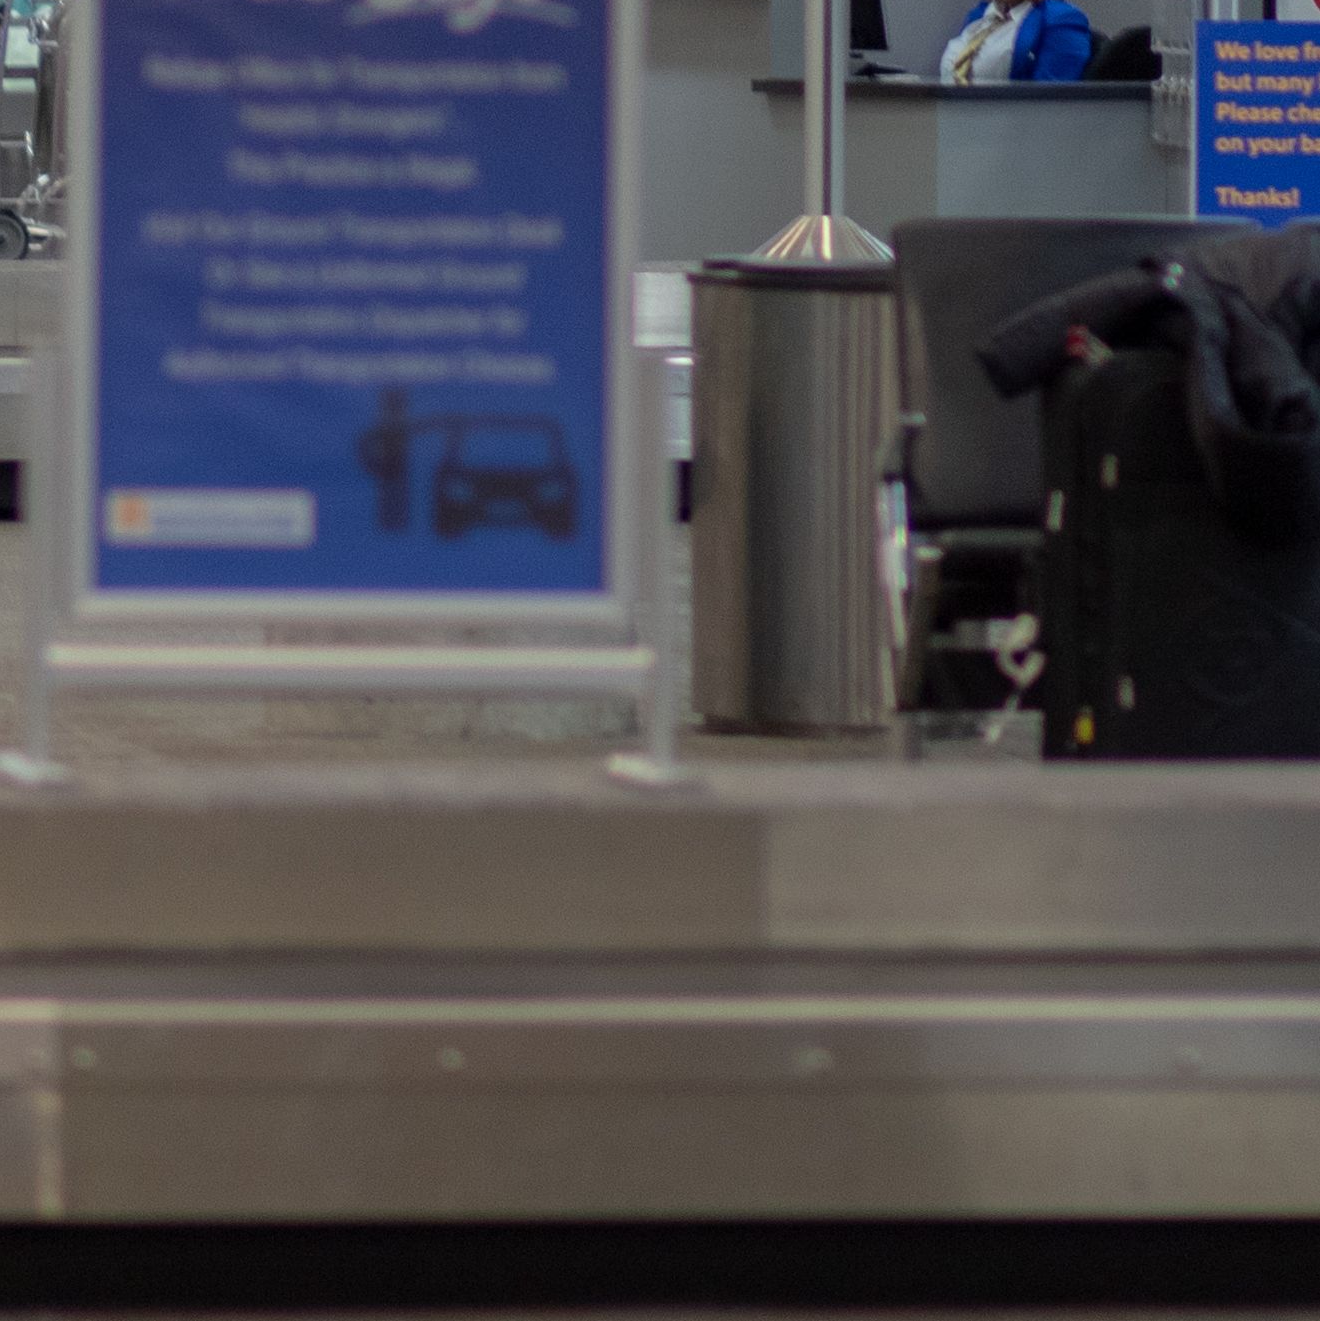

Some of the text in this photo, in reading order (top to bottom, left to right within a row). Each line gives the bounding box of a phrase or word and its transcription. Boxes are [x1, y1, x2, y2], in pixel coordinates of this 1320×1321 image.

[1214, 41, 1251, 61] We
[1255, 41, 1300, 61] love
[1214, 71, 1314, 96] but many
[1214, 101, 1283, 122] Please
[1214, 137, 1245, 153] on
[1247, 137, 1296, 158] your
[1214, 185, 1300, 208] Thanks!
